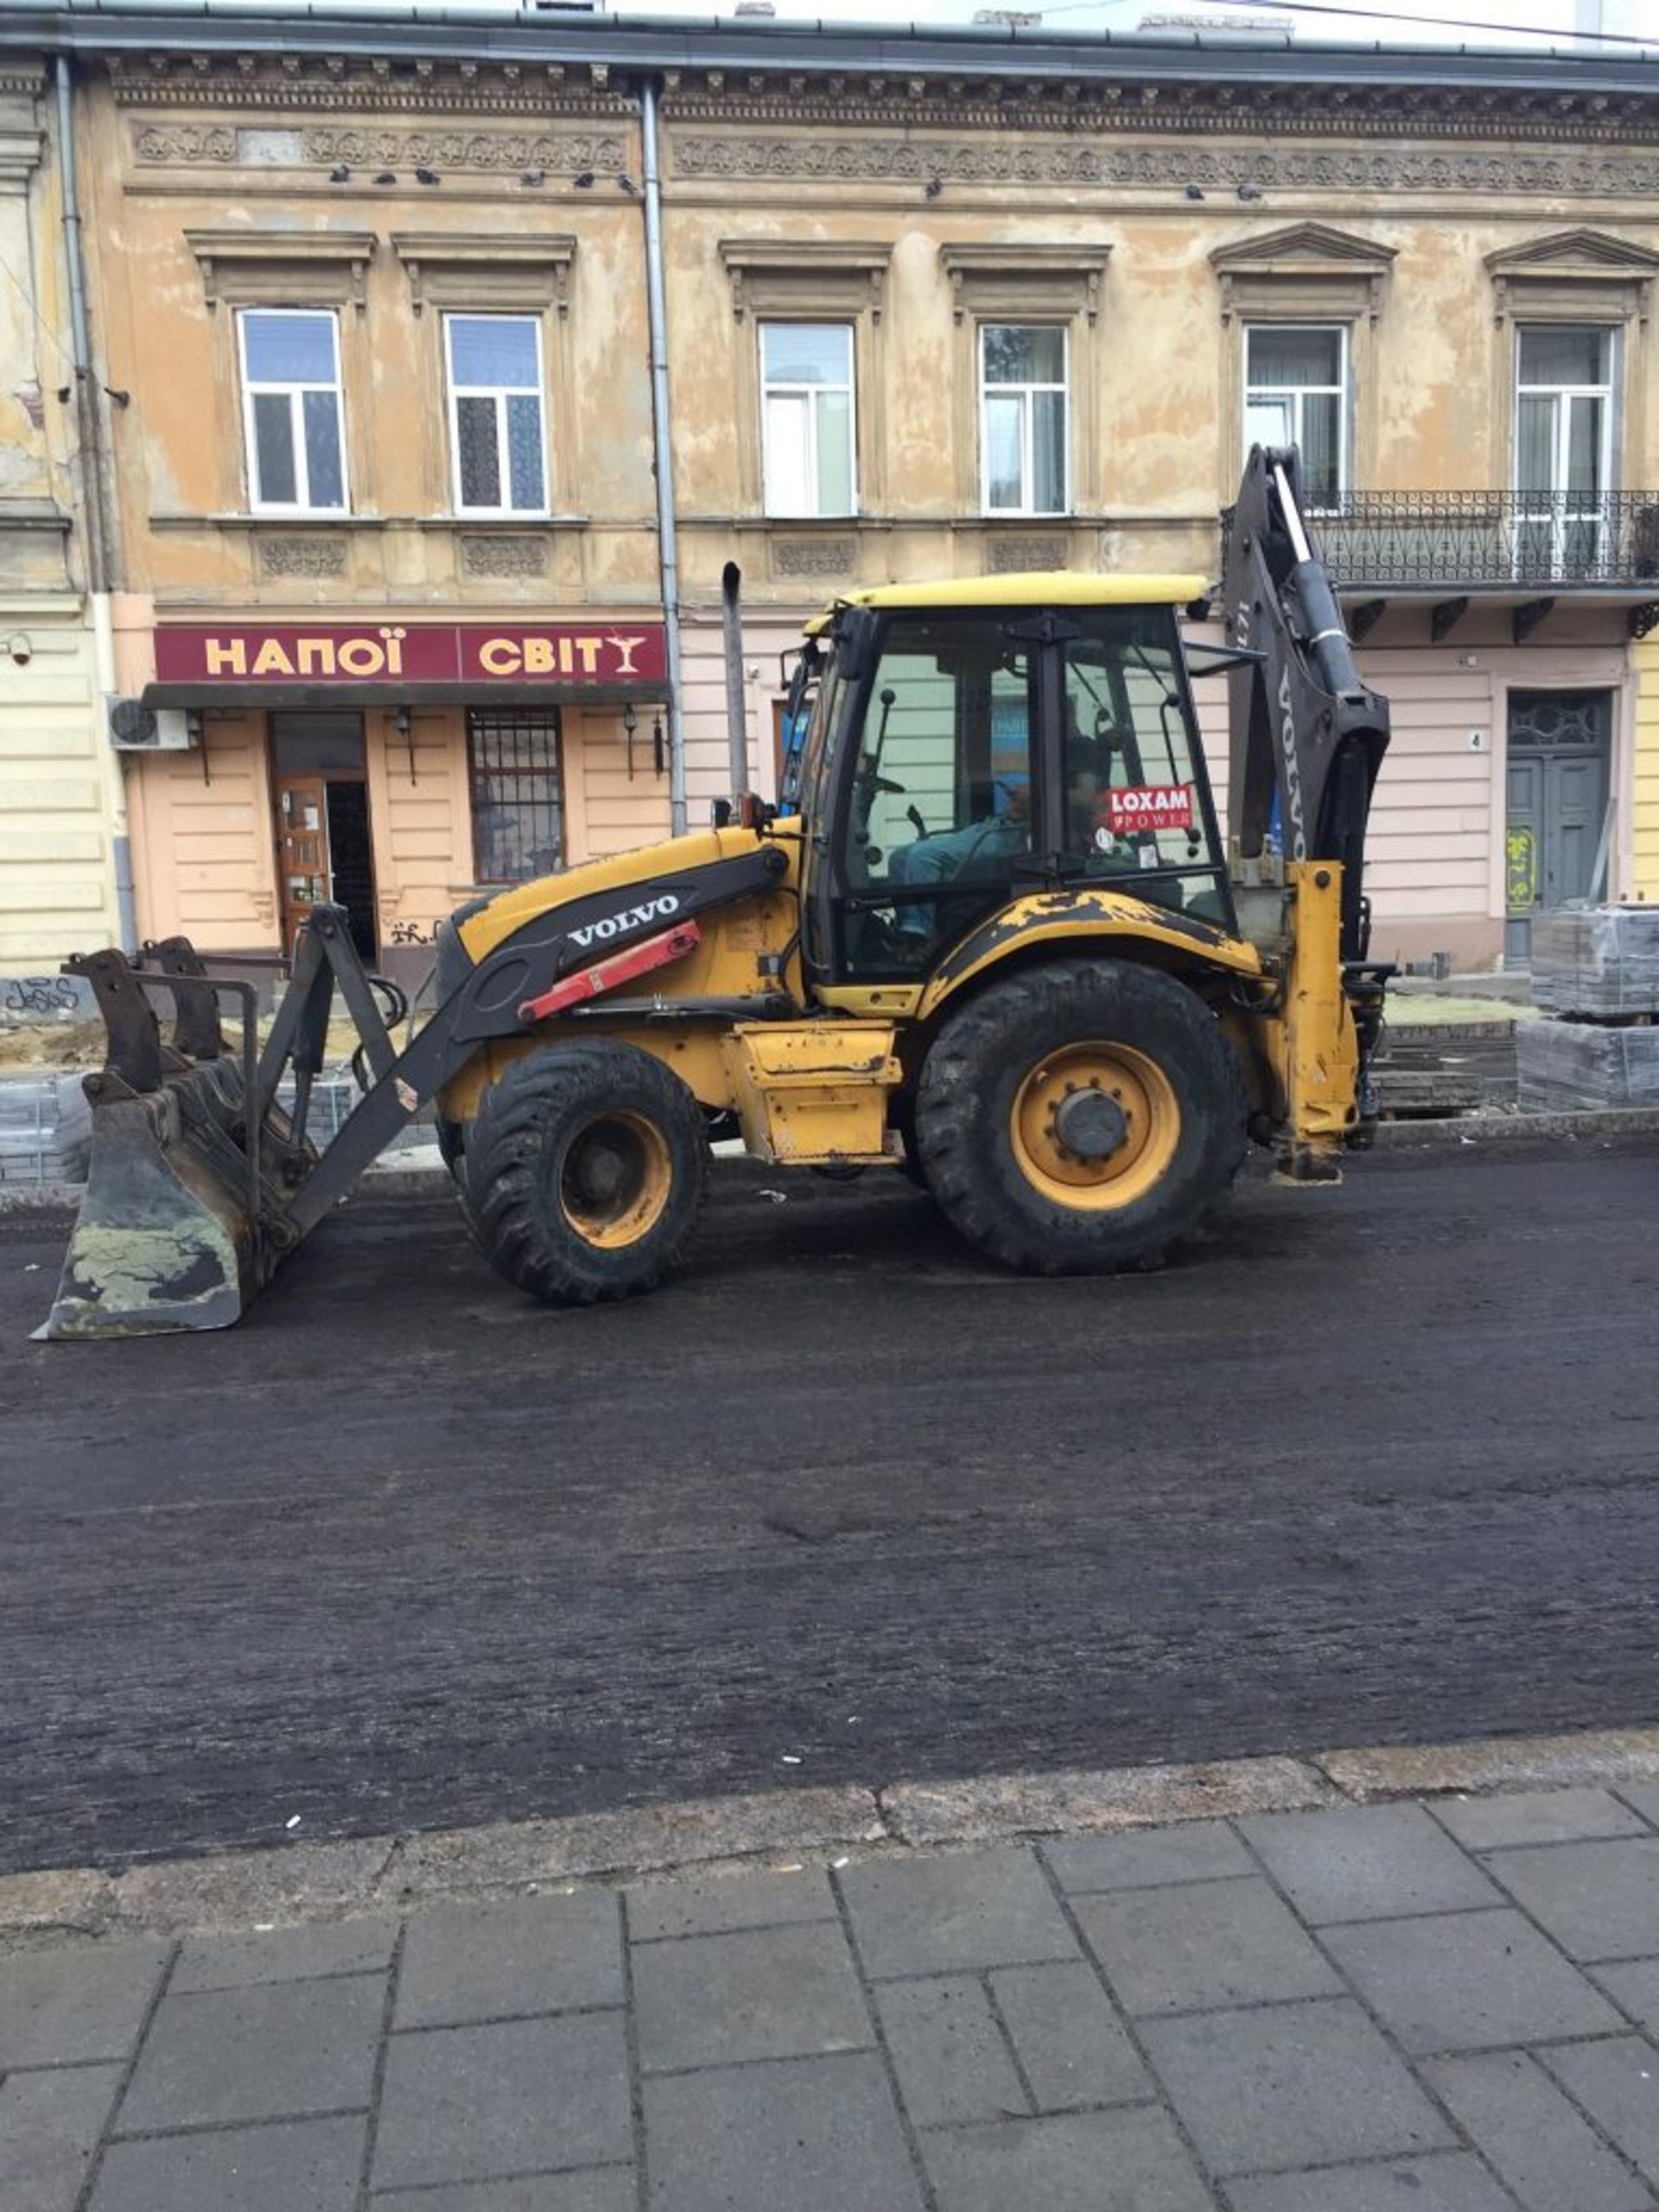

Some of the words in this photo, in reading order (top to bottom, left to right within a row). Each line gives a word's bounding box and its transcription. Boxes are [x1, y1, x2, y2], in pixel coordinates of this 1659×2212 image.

[205, 626, 407, 675] НАПОЇ
[1279, 663, 1306, 862] VOLVO
[1112, 790, 1189, 813] LOXAM
[1125, 813, 1190, 828] POWER
[567, 895, 679, 947] VOLVO
